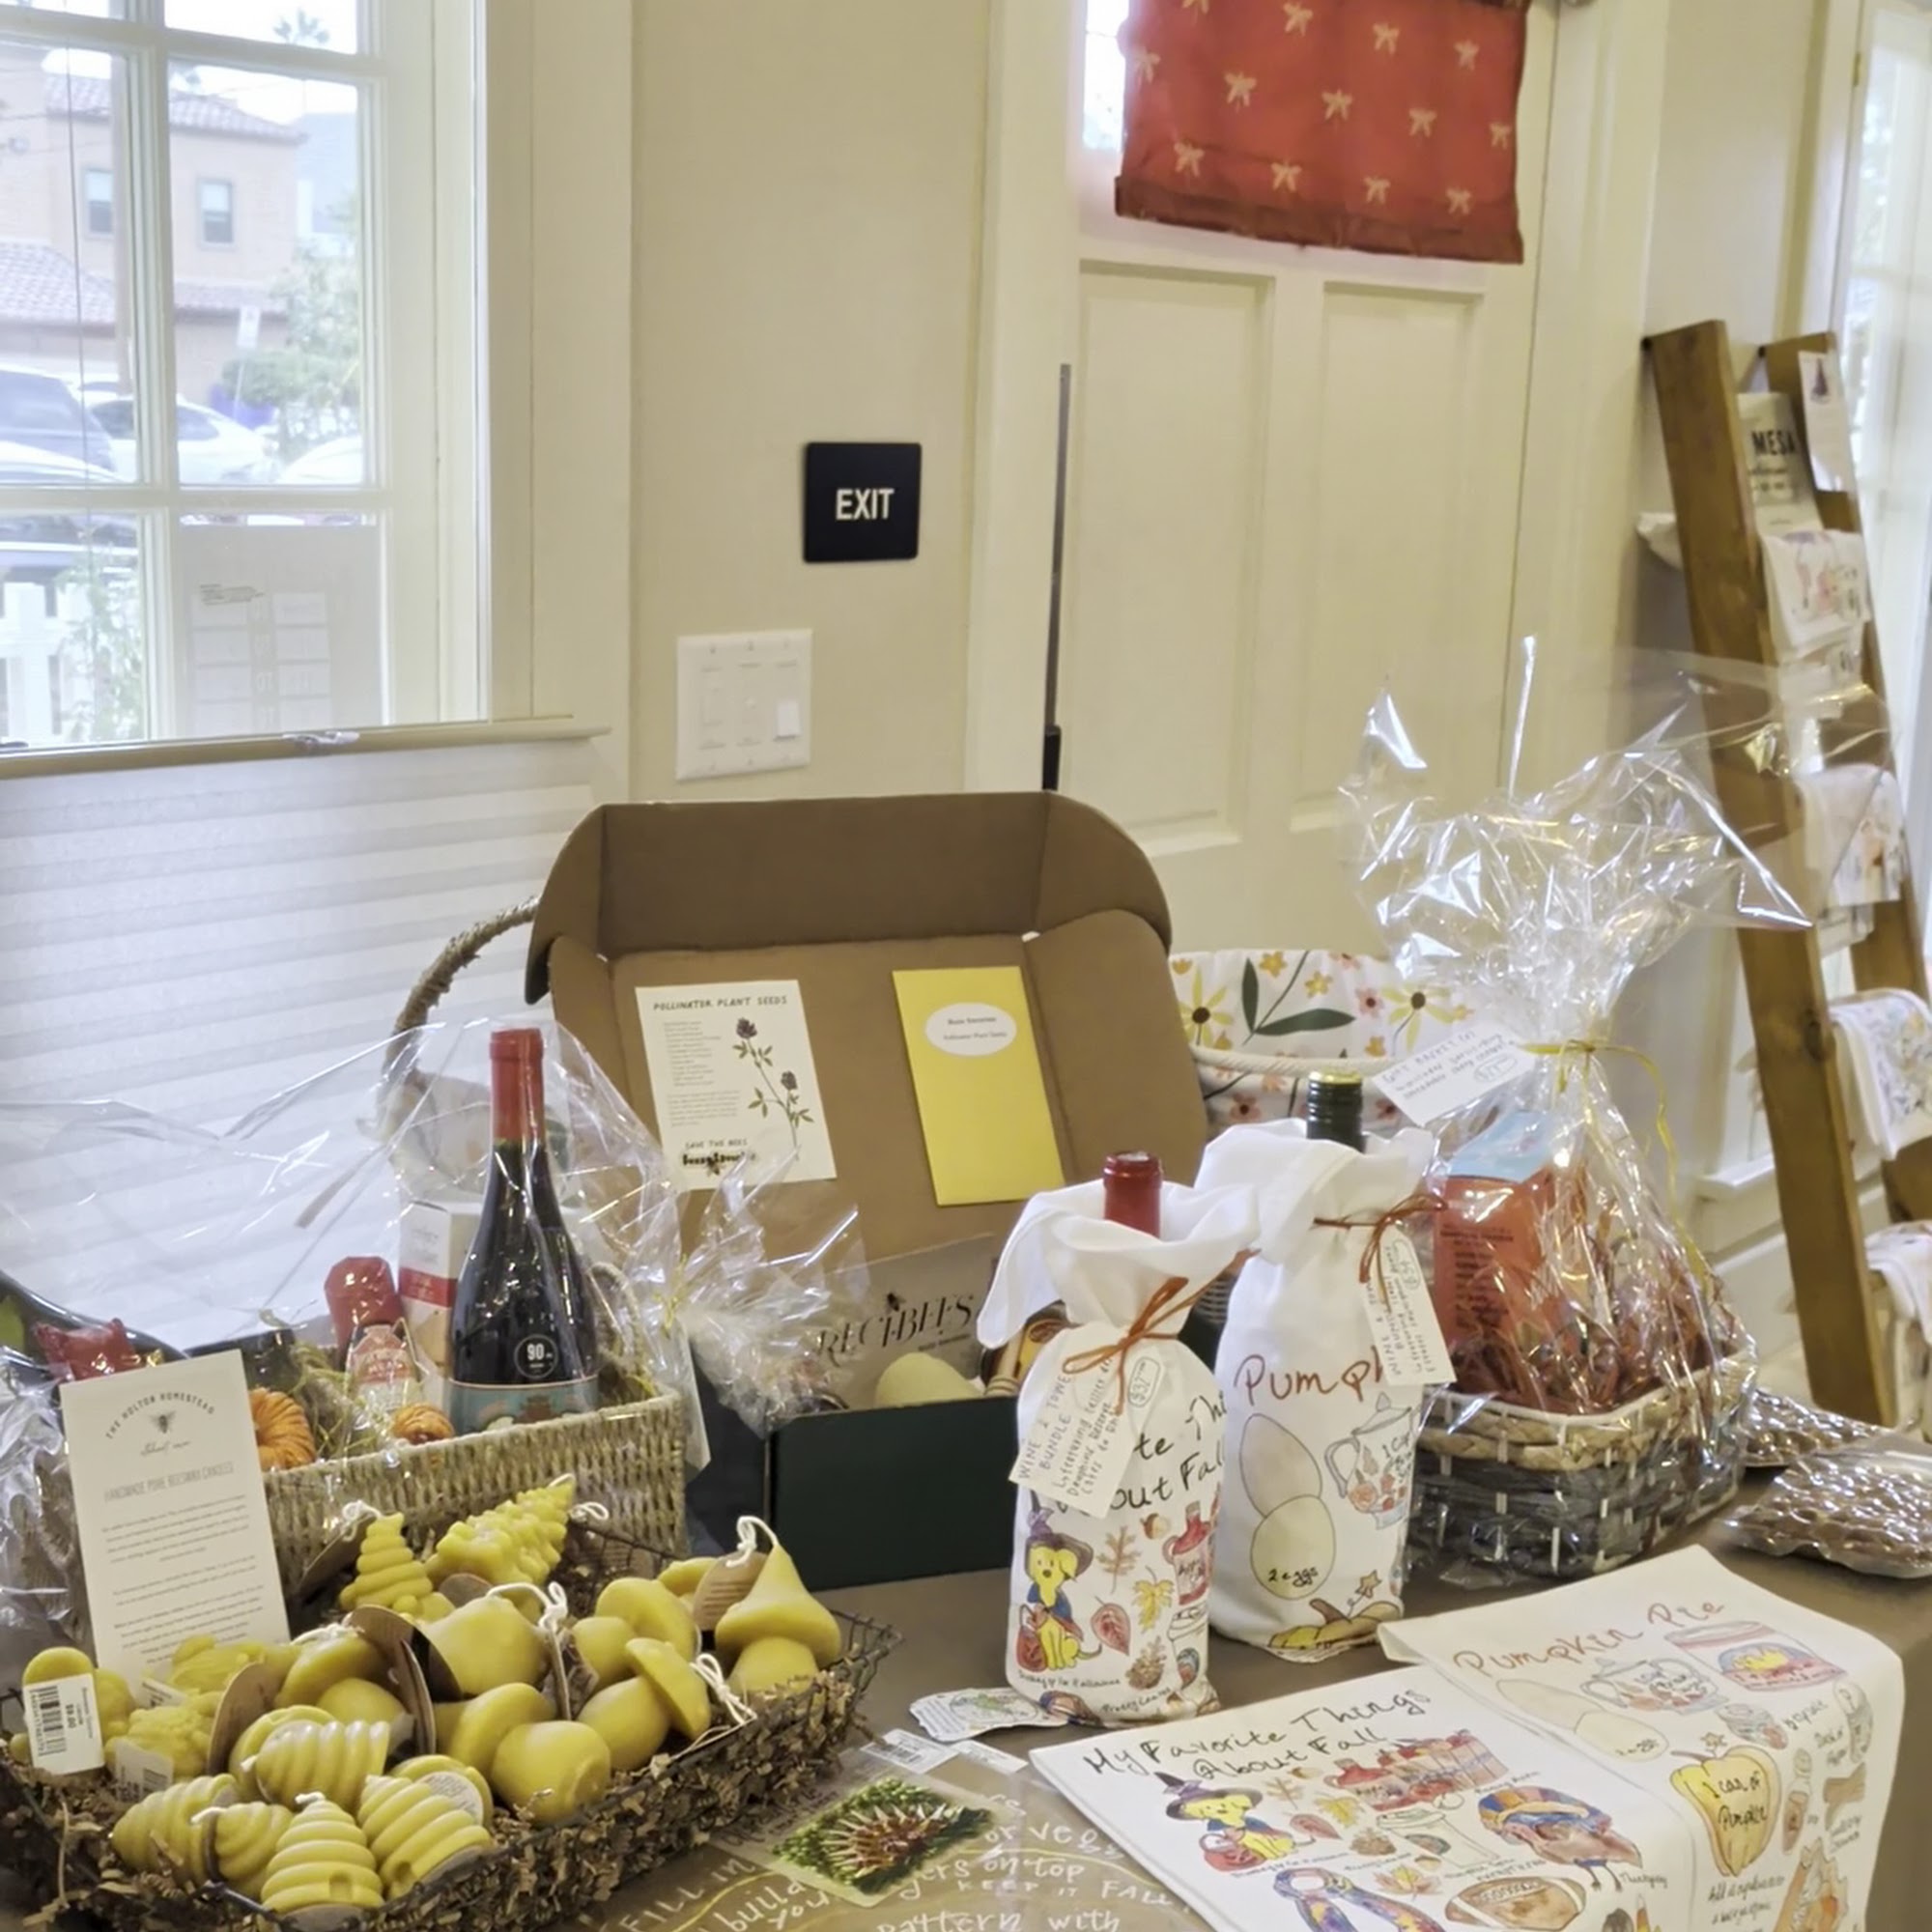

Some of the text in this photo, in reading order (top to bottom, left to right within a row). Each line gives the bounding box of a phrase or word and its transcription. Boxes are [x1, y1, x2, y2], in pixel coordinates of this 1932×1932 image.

[1751, 429, 1798, 458] MESA
[836, 488, 895, 521] EXIT
[717, 996, 753, 1009] PLANT
[757, 995, 787, 1007] SEEDS
[526, 1344, 544, 1361] 90
[104, 1419, 122, 1439] THE
[158, 1393, 216, 1415] HOMESTEAD
[1019, 1439, 1040, 1479] WINE
[1047, 1375, 1071, 1411] TOWE
[1039, 1414, 1071, 1470] BUNDLE
[1267, 1567, 1318, 1587] 2 eggs
[1453, 1603, 1724, 1678] Pumpkin Pie
[1084, 1689, 1431, 1776] My Favorite Things
[1193, 1727, 1388, 1778] About Fall
[713, 1880, 807, 1931] build
[1023, 1858, 1085, 1883] top
[1047, 1908, 1122, 1932] with
